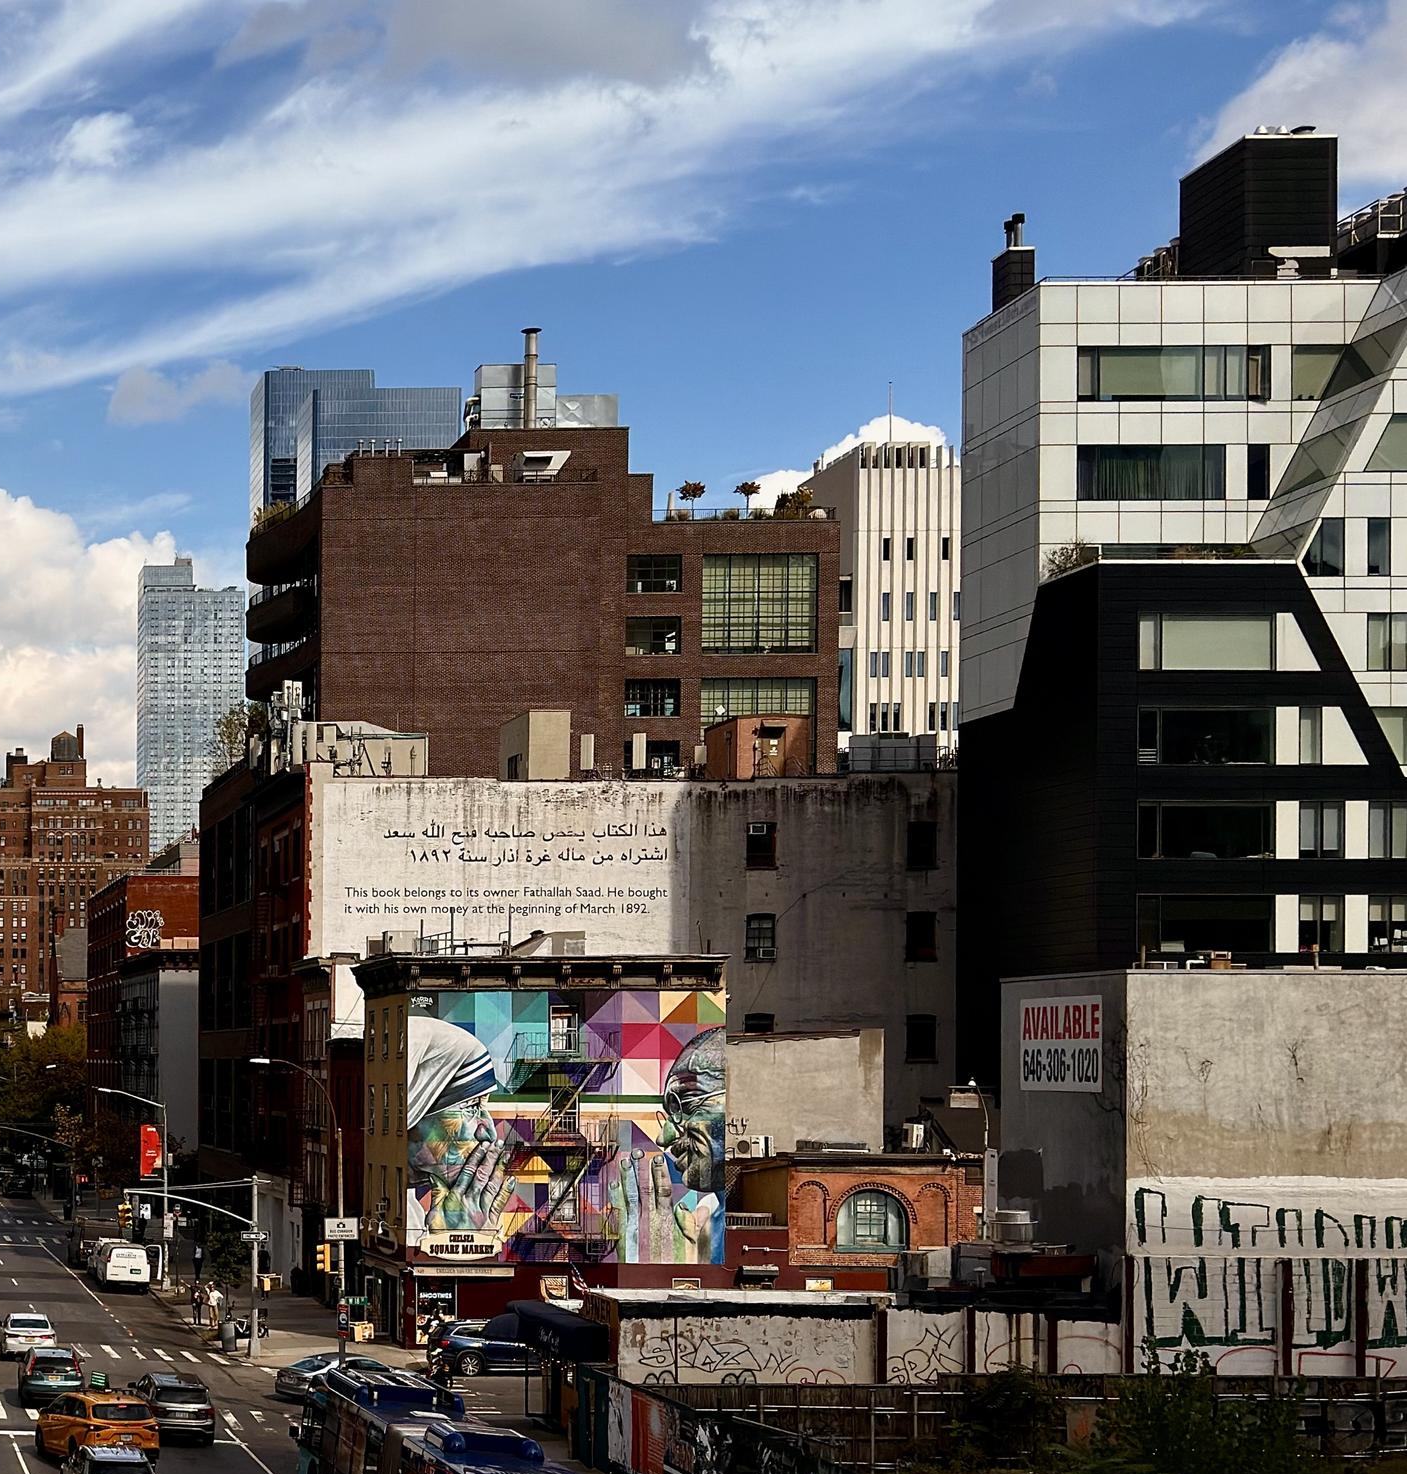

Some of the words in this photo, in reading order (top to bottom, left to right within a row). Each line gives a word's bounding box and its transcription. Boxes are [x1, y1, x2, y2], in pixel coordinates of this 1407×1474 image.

[383, 827, 415, 839] سعد
[421, 819, 445, 838] الله
[451, 825, 477, 845] فتح
[484, 824, 536, 843] صاحبه
[592, 823, 638, 843] الكتاب
[644, 822, 667, 838] هذا
[410, 849, 451, 863] ١٨٩٢
[458, 847, 487, 862] سنة
[592, 852, 614, 865] من
[620, 846, 668, 864] اشتراه
[344, 886, 368, 898] This
[371, 886, 401, 898] book
[404, 887, 446, 900] belongs
[450, 888, 462, 898] to
[466, 887, 479, 898] its
[483, 889, 520, 898] owner
[523, 886, 572, 898] Fathallah
[576, 886, 604, 898] Saad.
[607, 887, 624, 898] He
[628, 886, 669, 901] bought
[344, 903, 353, 914] it
[355, 903, 380, 914] with
[383, 903, 399, 914] his
[402, 905, 427, 914] own
[431, 905, 469, 917] money
[472, 905, 483, 914] at
[486, 903, 505, 914] the
[509, 903, 561, 916] beginning
[565, 903, 579, 914] of
[580, 903, 615, 914] March
[621, 903, 650, 914] 1892.
[1023, 1004, 1100, 1040] AVAILABLE
[1023, 1048, 1099, 1083] 646-306-1020
[449, 1234, 475, 1243] CHELSEA
[429, 1245, 460, 1255] SQUARE
[461, 1245, 495, 1255] MARKET
